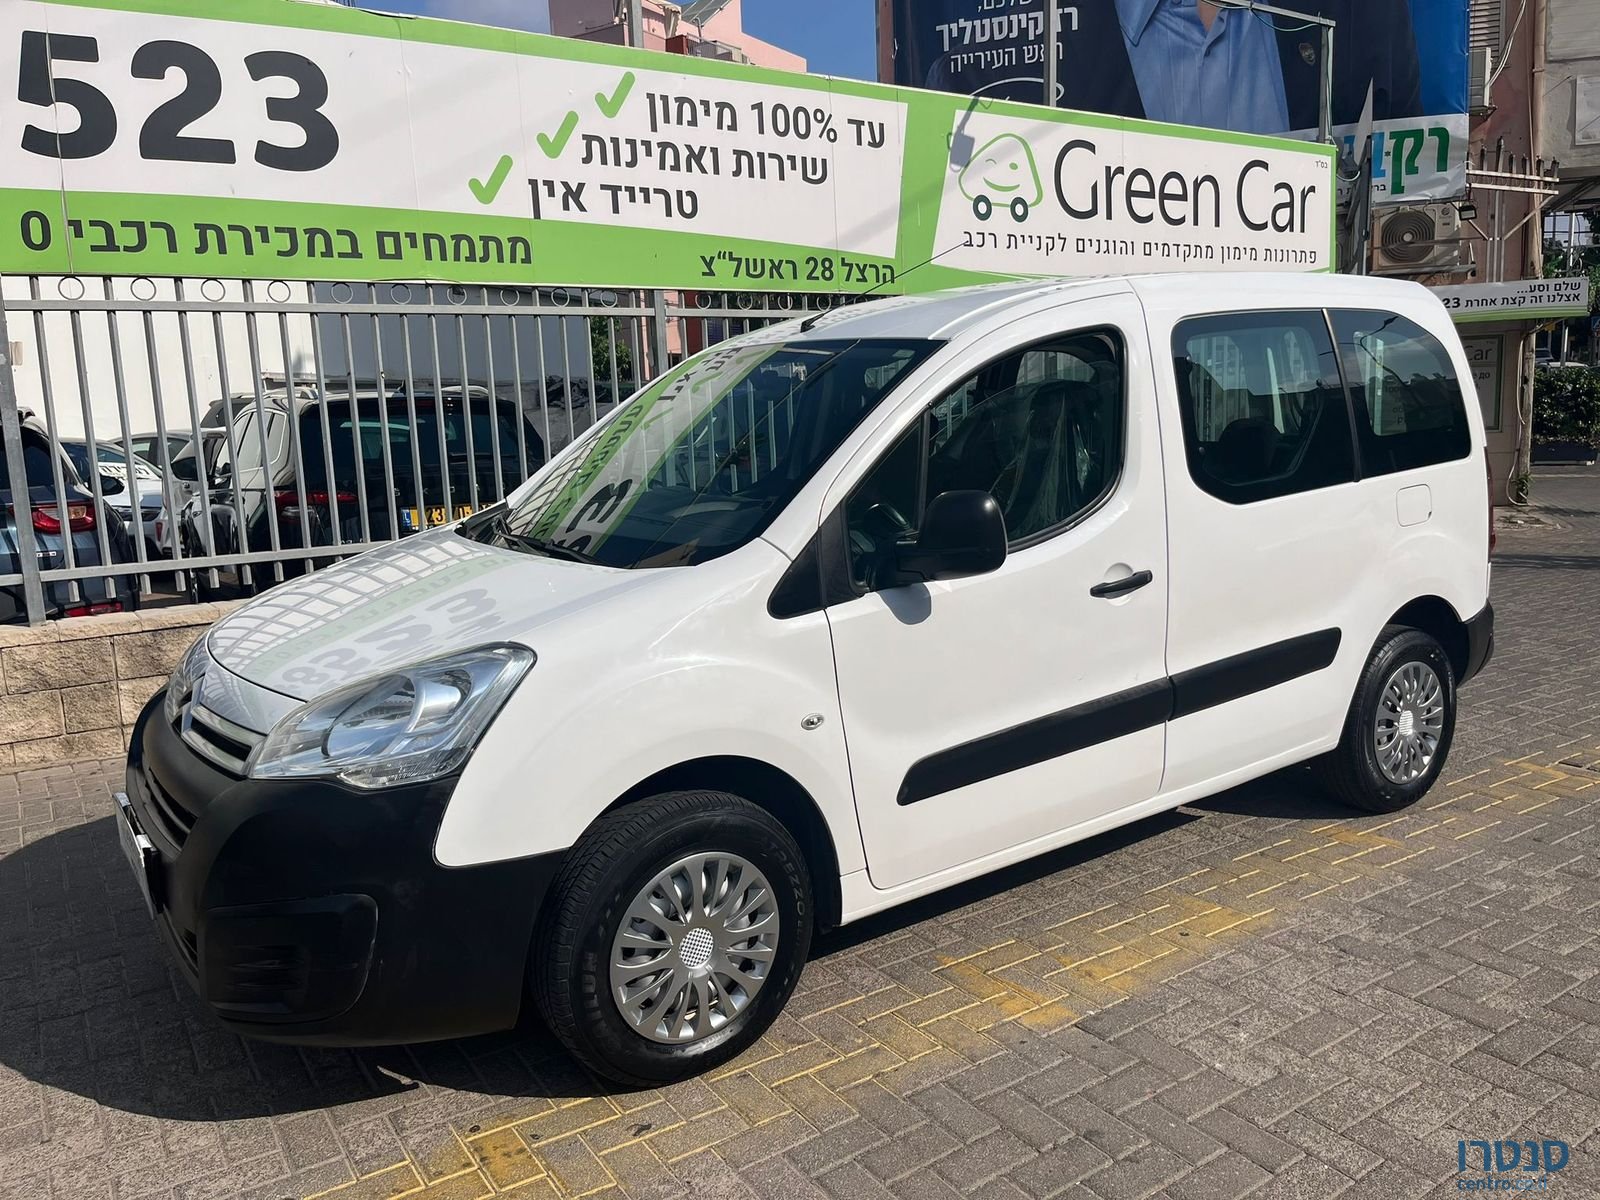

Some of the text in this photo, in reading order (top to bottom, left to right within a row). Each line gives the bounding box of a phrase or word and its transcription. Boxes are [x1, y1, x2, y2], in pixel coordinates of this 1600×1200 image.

[935, 11, 1044, 52] קינסטליך
[950, 47, 1016, 73] העירייה
[18, 31, 339, 171] 523
[646, 93, 884, 148] עד 100% מימון
[582, 130, 827, 184] שירות ואמינות
[528, 179, 698, 219] טרייד אין
[1054, 139, 1318, 233] Green Car
[21, 211, 531, 264] מתמחים במכירת רכבי 0
[963, 230, 1316, 264] פתרונות מימון מתקדמים והוגנים לקניית רכב
[806, 257, 833, 281] 28
[841, 256, 895, 284] הרצל
[1501, 296, 1525, 306] קצת
[1531, 295, 1543, 303] זה
[1547, 293, 1580, 302] אצלנו
[1554, 281, 1580, 291] שלם
[1465, 298, 1496, 307] אחרת
